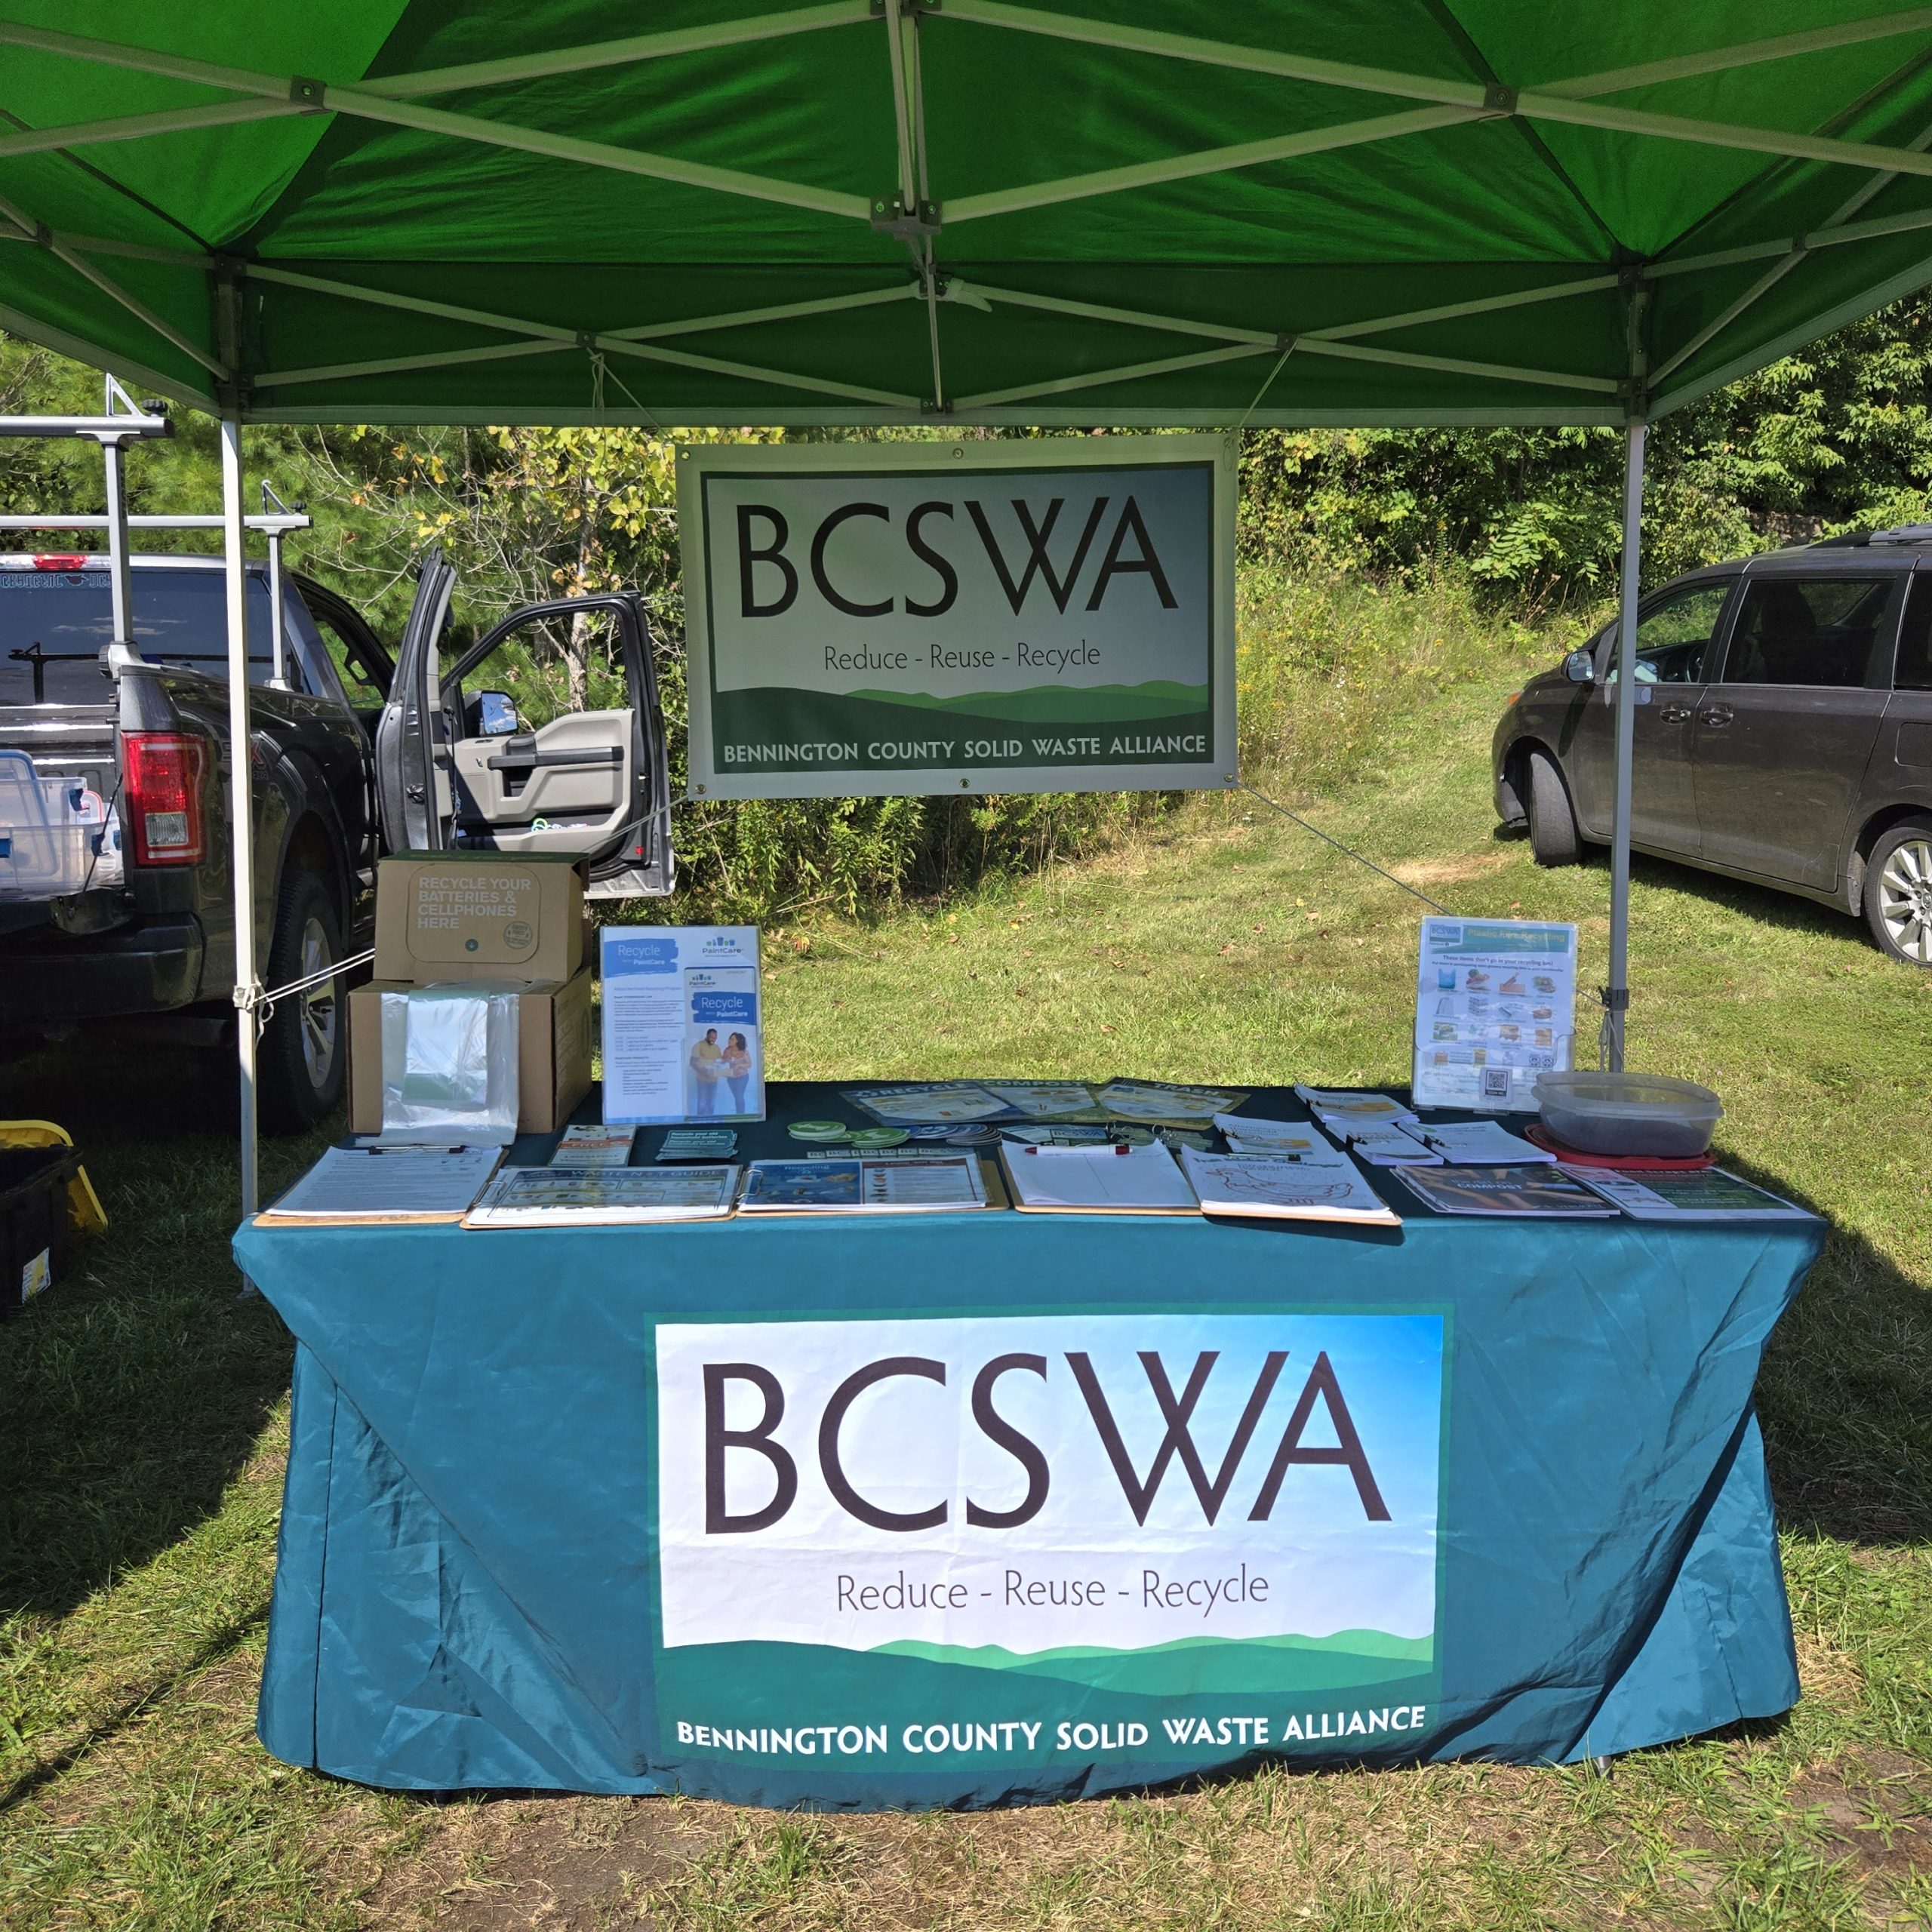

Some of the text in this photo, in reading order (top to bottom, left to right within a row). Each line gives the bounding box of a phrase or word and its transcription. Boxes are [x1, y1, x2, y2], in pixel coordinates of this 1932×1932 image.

[736, 495, 1179, 618] BCSWA
[824, 645, 908, 671] Reduce
[931, 643, 995, 670] Reuse
[1017, 638, 1101, 674] Recycle
[724, 734, 1206, 764] BENNINGTON COUNTY SOLID WASTE ALLIANCE
[419, 877, 531, 891] RECYCLE YOUR
[419, 891, 516, 904] BATTERIES &
[418, 904, 517, 917] CELLPHONES
[417, 917, 460, 929] HERE
[618, 945, 661, 958] Recycle
[702, 997, 743, 1010] Recycle
[880, 1082, 968, 1096] RECYCLE
[1155, 1082, 1220, 1096] TRASH
[702, 1350, 1392, 1534] BCSWA
[836, 1571, 968, 1612] Reduce
[1005, 1569, 1106, 1607] Reuse
[1143, 1563, 1269, 1617] Recycle
[677, 1705, 1426, 1755] BENNINGTON COUNTY SOLID WASTE ALLIANCE
